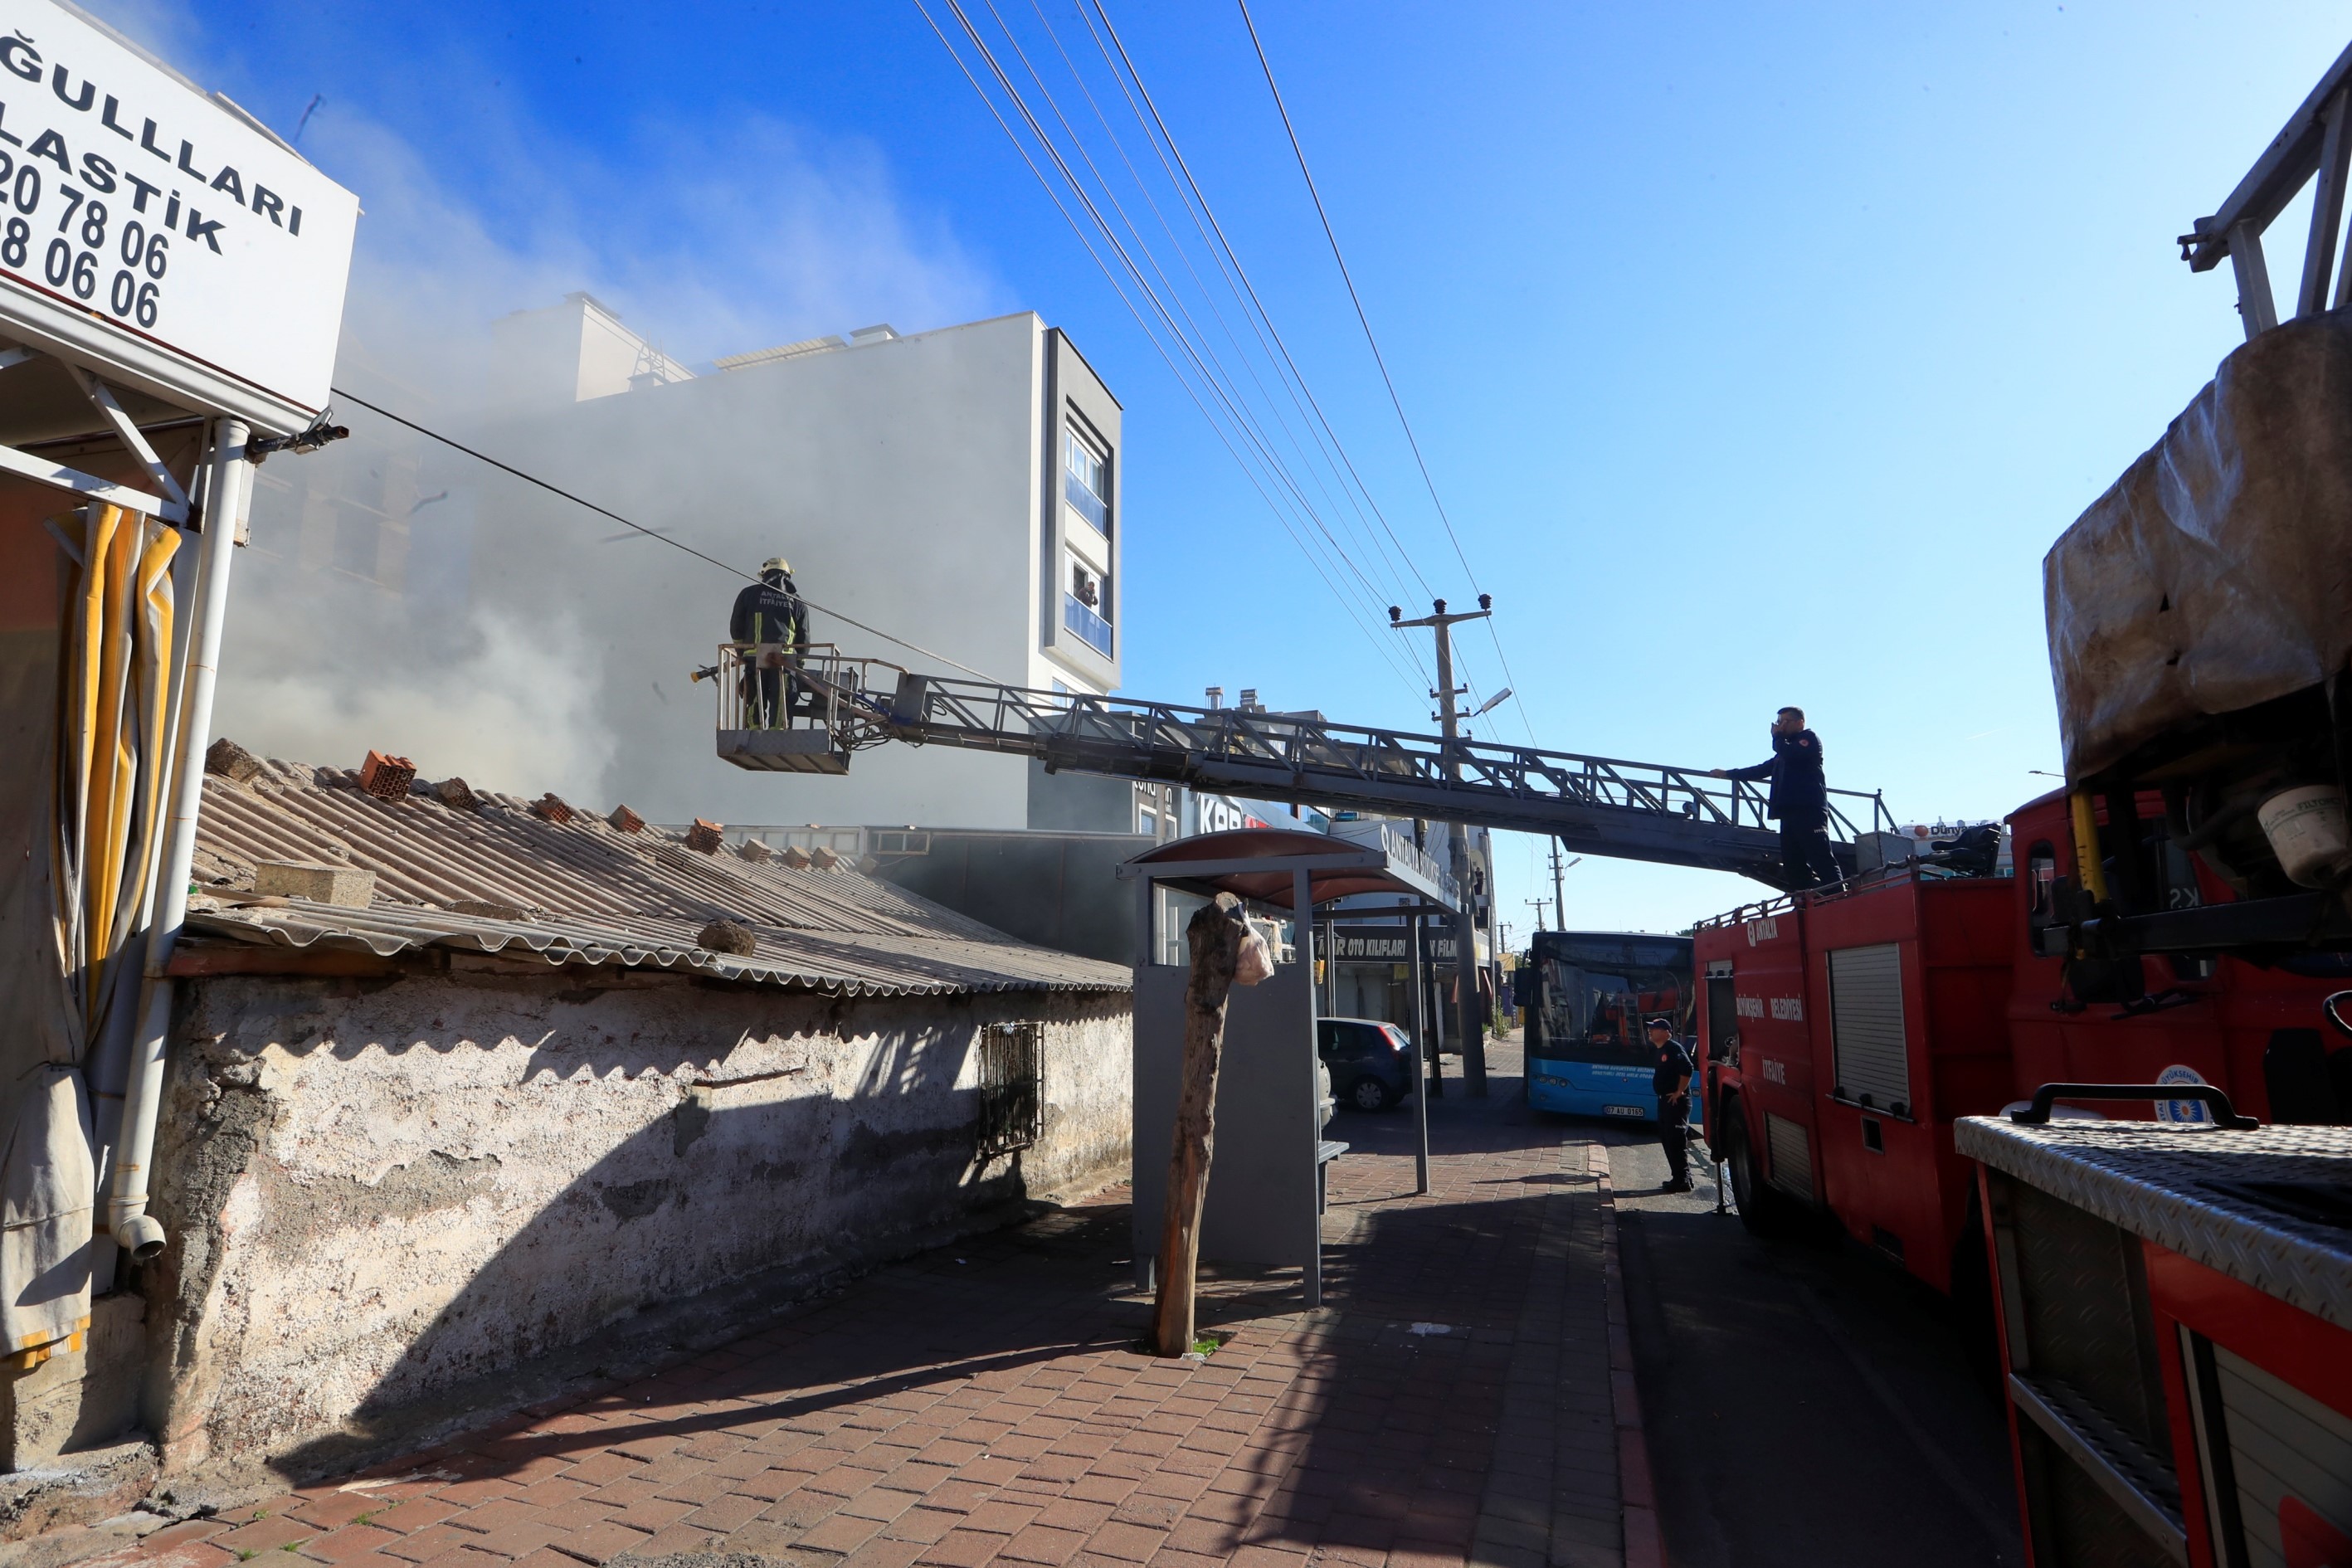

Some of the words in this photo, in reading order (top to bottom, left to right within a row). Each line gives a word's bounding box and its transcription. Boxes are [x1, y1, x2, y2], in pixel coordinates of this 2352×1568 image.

[0, 28, 303, 237] ĞULLLARI
[57, 183, 108, 249] 78
[121, 220, 169, 280] 06
[45, 237, 99, 299] 06
[110, 269, 160, 329] 06
[1390, 829, 1421, 875] ANTALYA
[1347, 938, 1365, 956] OTO
[1366, 939, 1406, 957] KILIFLARI
[1755, 917, 1778, 942] ANTALYA
[1736, 993, 1765, 1022] BÜYÜKŞEHİR
[1770, 993, 1803, 1021] BELEDİYESİ
[1762, 1055, 1785, 1085] İTFAİYE
